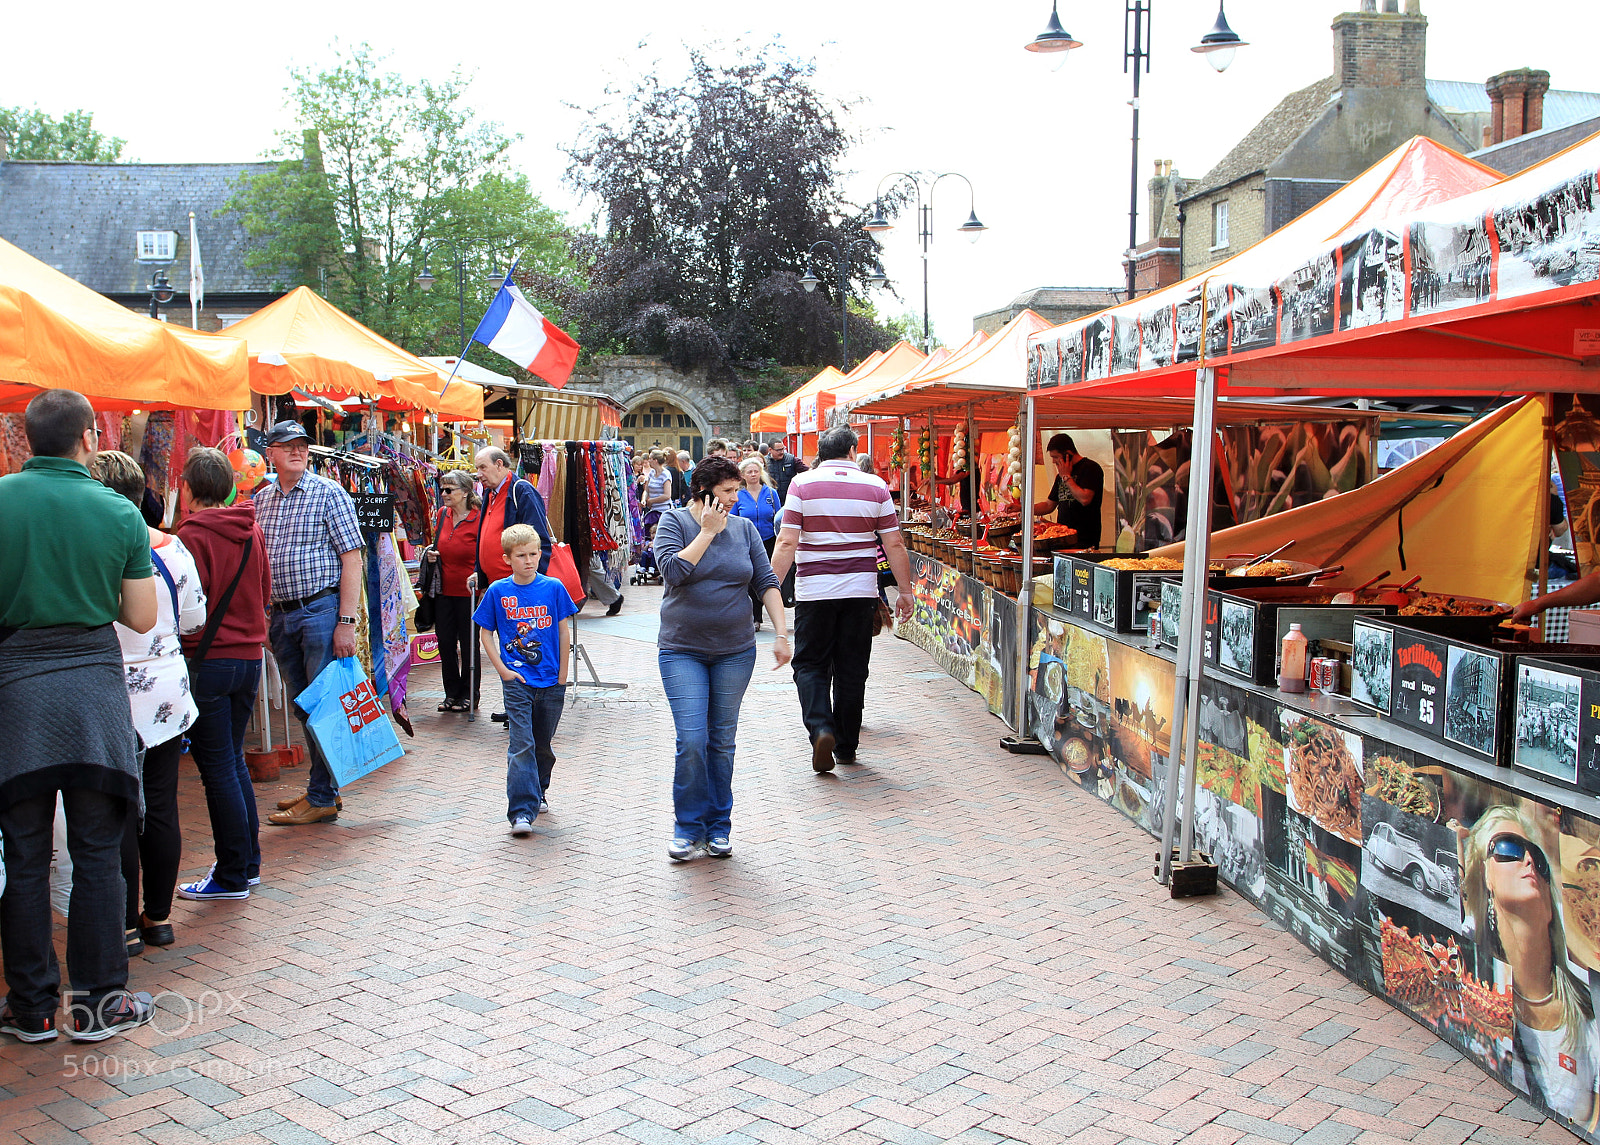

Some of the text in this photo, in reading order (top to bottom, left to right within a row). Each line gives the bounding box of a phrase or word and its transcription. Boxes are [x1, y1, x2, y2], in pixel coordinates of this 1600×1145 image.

[501, 596, 517, 608] GO
[506, 605, 547, 619] MARIO
[537, 616, 552, 629] GO
[1401, 679, 1436, 695] small large
[1418, 697, 1435, 725] £5
